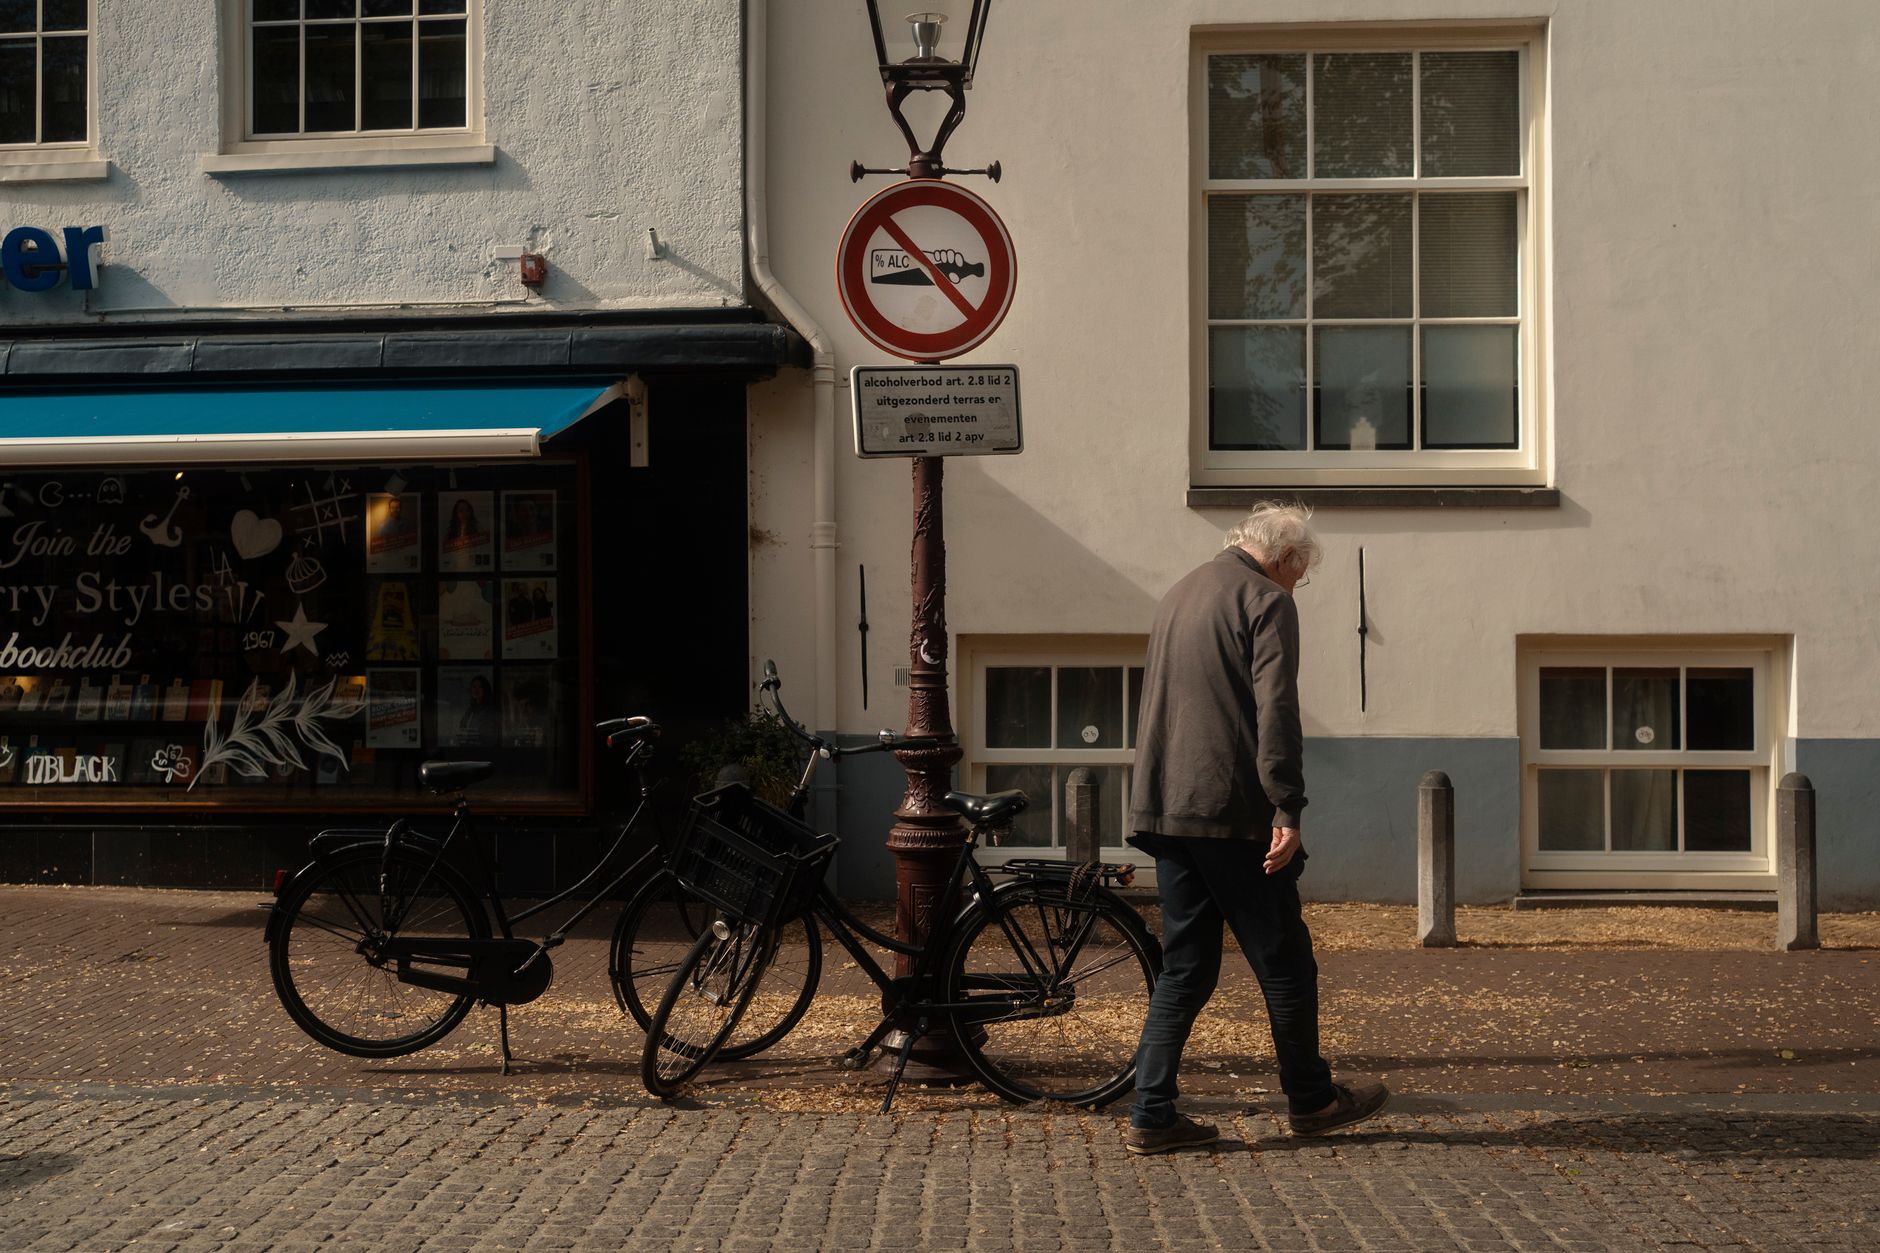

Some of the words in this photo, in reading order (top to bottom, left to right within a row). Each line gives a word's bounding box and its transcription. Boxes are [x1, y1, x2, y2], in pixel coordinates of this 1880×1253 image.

[2, 226, 104, 292] er
[887, 254, 910, 269] ALC
[864, 376, 942, 388] alcoholverbod
[946, 377, 964, 387] art.
[968, 376, 984, 386] 2.8
[988, 375, 1001, 386] lid
[1004, 375, 1011, 386] 2
[876, 395, 950, 408] uitgezonderd
[953, 395, 985, 405] terras
[904, 414, 977, 424] evenementen
[899, 434, 914, 443] art
[918, 432, 935, 443] 2.8
[938, 432, 951, 442] lid
[955, 432, 962, 442] 2
[965, 433, 985, 444] apv
[0, 520, 76, 569] Join
[86, 522, 133, 556] the
[0, 584, 59, 627] ry
[75, 570, 214, 627] Styles
[0, 631, 133, 670] bookclub
[242, 630, 275, 651] 1967
[25, 755, 117, 784] 17BLACK
